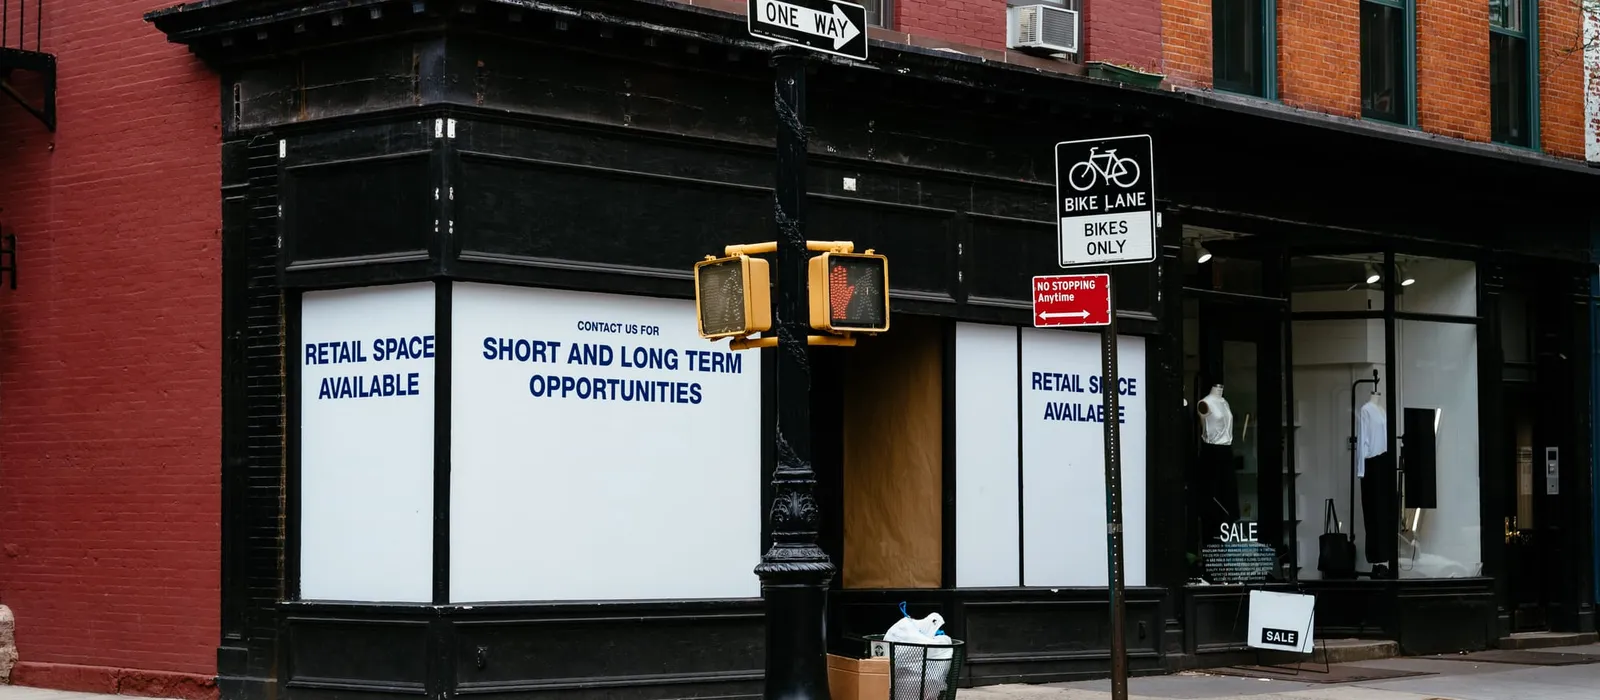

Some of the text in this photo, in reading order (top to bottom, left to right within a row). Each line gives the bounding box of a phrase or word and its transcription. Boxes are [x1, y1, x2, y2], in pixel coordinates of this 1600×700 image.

[766, 2, 799, 28] ONE
[814, 13, 848, 39] WAY
[1065, 192, 1146, 212] BIKE LANE
[1084, 220, 1128, 237] BIKES
[1086, 239, 1127, 256] ONLY
[1037, 280, 1096, 291] NO STOPPING
[1038, 292, 1075, 304] Anytime
[577, 320, 659, 336] CONTACT US FOR
[305, 335, 435, 365] RETAIL SPACE
[482, 336, 742, 374] SHORT AND LONG TERM
[319, 372, 419, 399] AVAILABLE
[529, 374, 702, 404] OPPORTUNITIES
[1032, 372, 1137, 396] RETAIL SCE
[1043, 402, 1125, 424] AVAILABE
[1220, 522, 1258, 542] SALE
[1266, 631, 1295, 643] SALE
